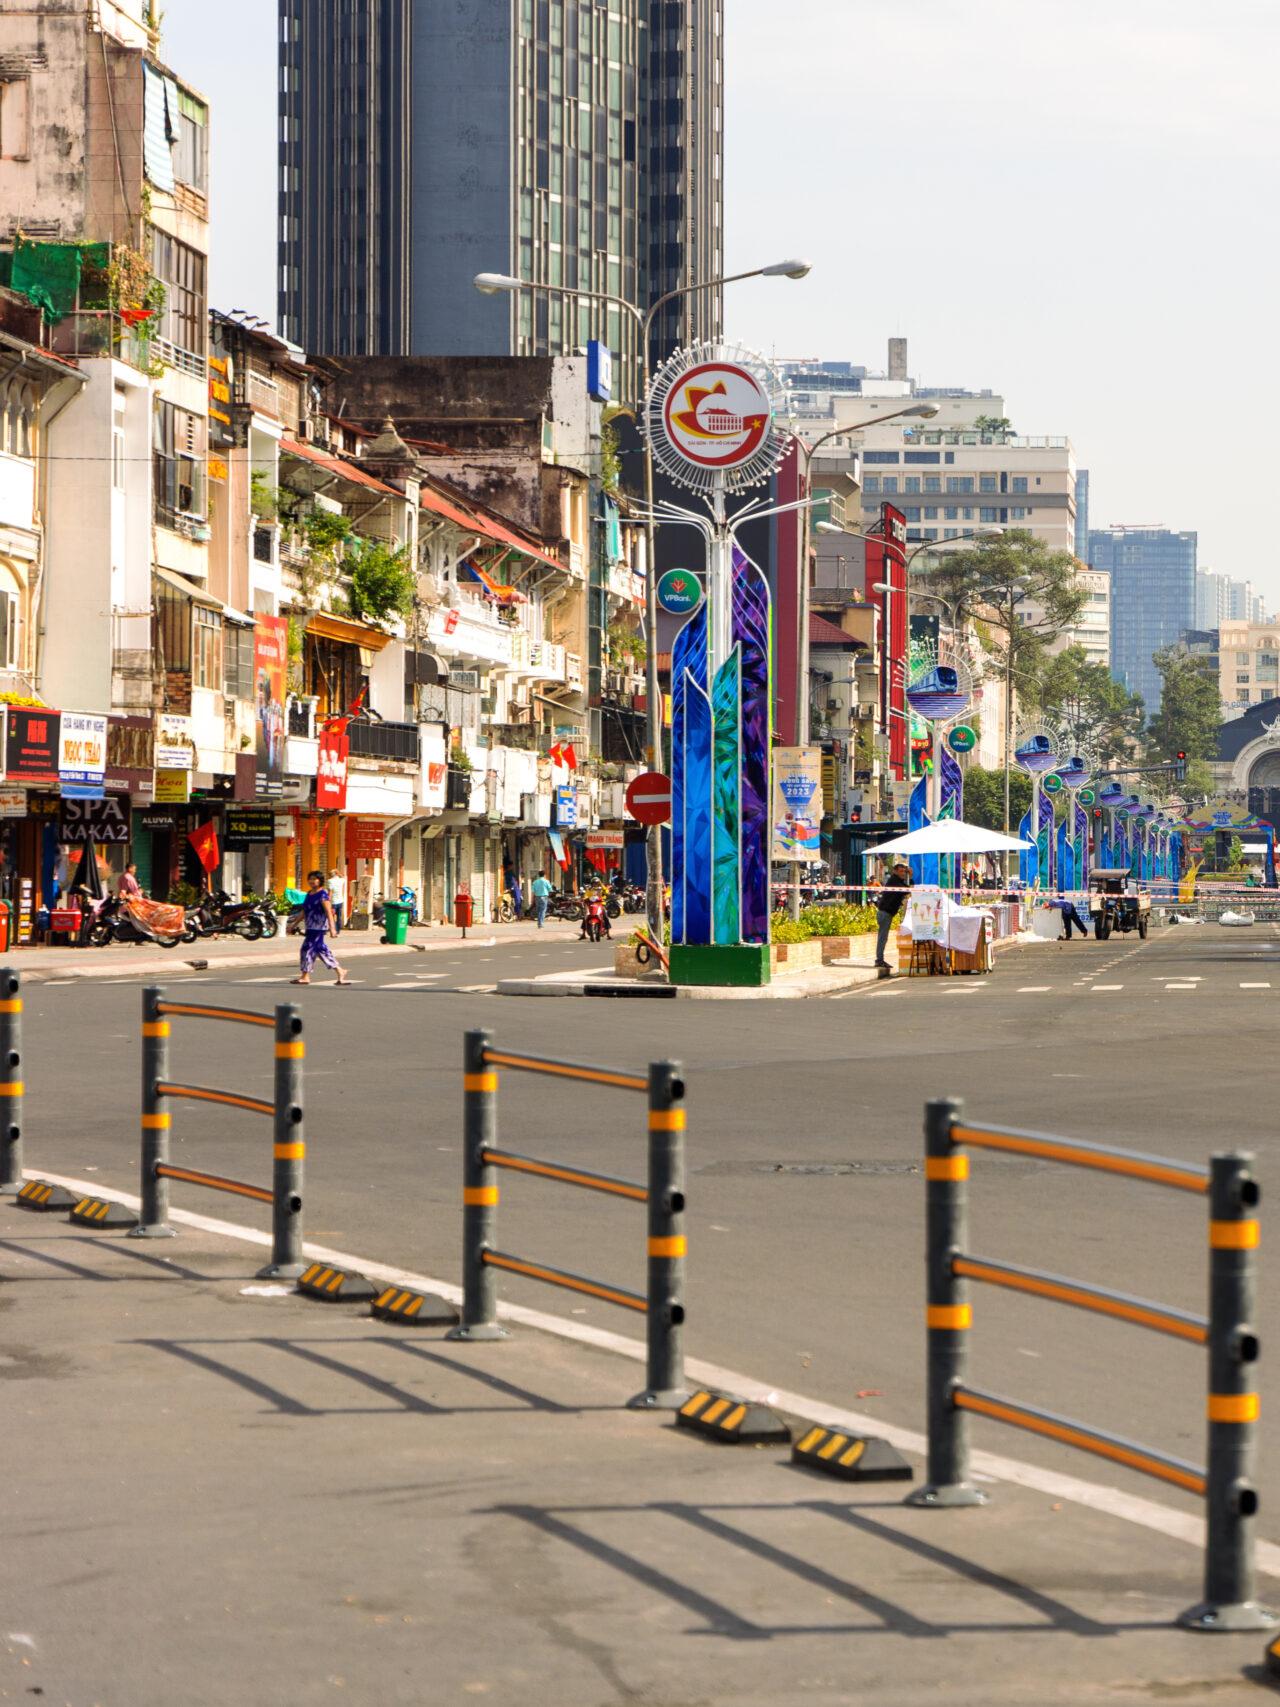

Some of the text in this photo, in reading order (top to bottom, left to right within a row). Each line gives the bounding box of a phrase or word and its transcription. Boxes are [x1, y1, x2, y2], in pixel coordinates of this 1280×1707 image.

[787, 787, 810, 796] 2023
[65, 800, 125, 820] SPA
[142, 816, 174, 825] ALUVIA
[62, 824, 129, 840] KAKA2
[231, 822, 247, 832] XQ
